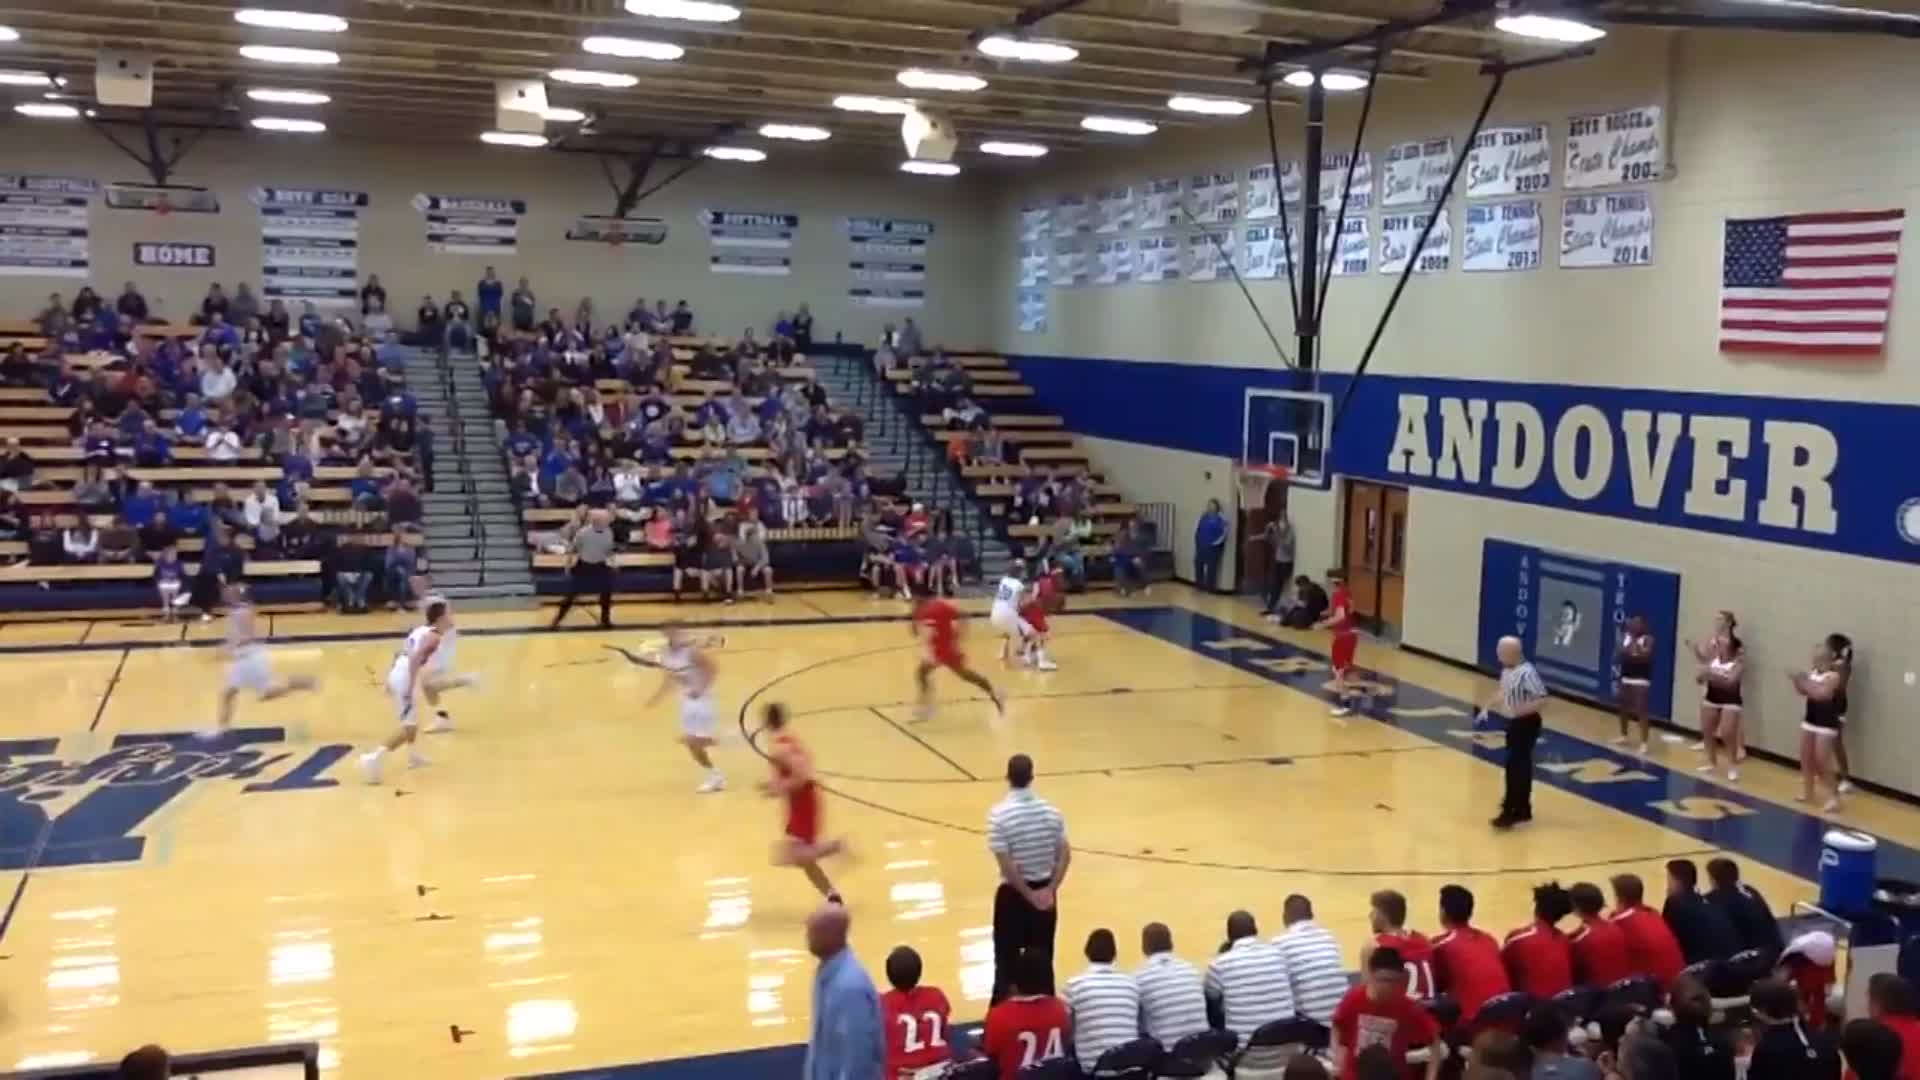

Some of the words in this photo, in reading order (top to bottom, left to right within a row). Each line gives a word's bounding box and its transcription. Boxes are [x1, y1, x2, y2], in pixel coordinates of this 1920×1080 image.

[1473, 133, 1496, 149] OYS
[1502, 128, 1543, 146] TENNIS
[1569, 119, 1599, 136] BOYS
[140, 246, 211, 265] HOME
[1613, 246, 1648, 263] 2014
[1387, 395, 1838, 535] ANDOVER
[1404, 960, 1434, 1000] 21
[898, 1011, 947, 1053] 22
[1018, 1027, 1064, 1070] 24
